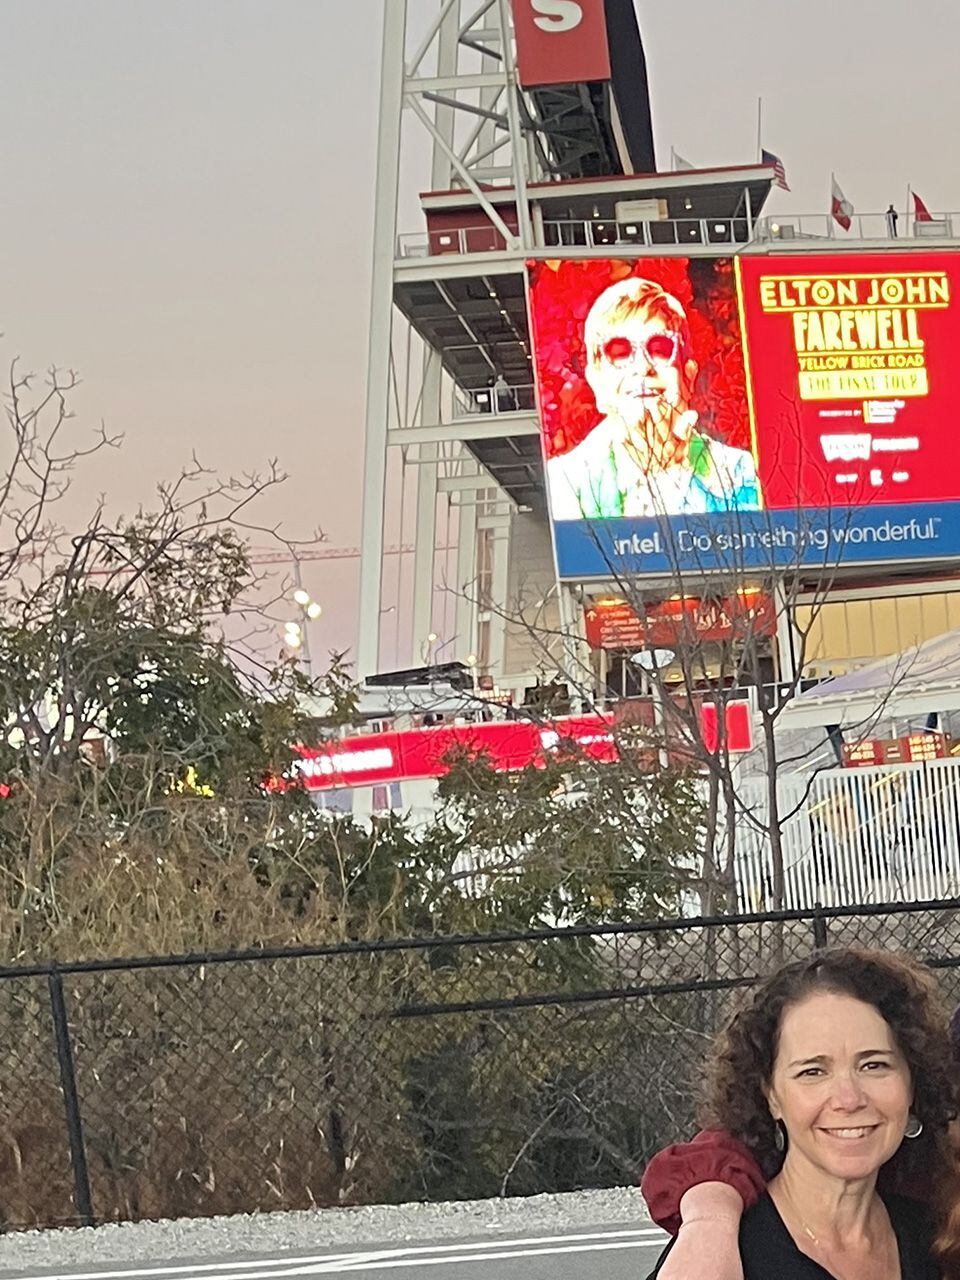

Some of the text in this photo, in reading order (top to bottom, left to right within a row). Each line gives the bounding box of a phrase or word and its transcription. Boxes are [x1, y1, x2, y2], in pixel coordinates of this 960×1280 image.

[760, 277, 949, 306] ELTON JOHN
[793, 309, 924, 351] FAREWELL
[798, 354, 924, 371] YELLOW BRICK ROAD
